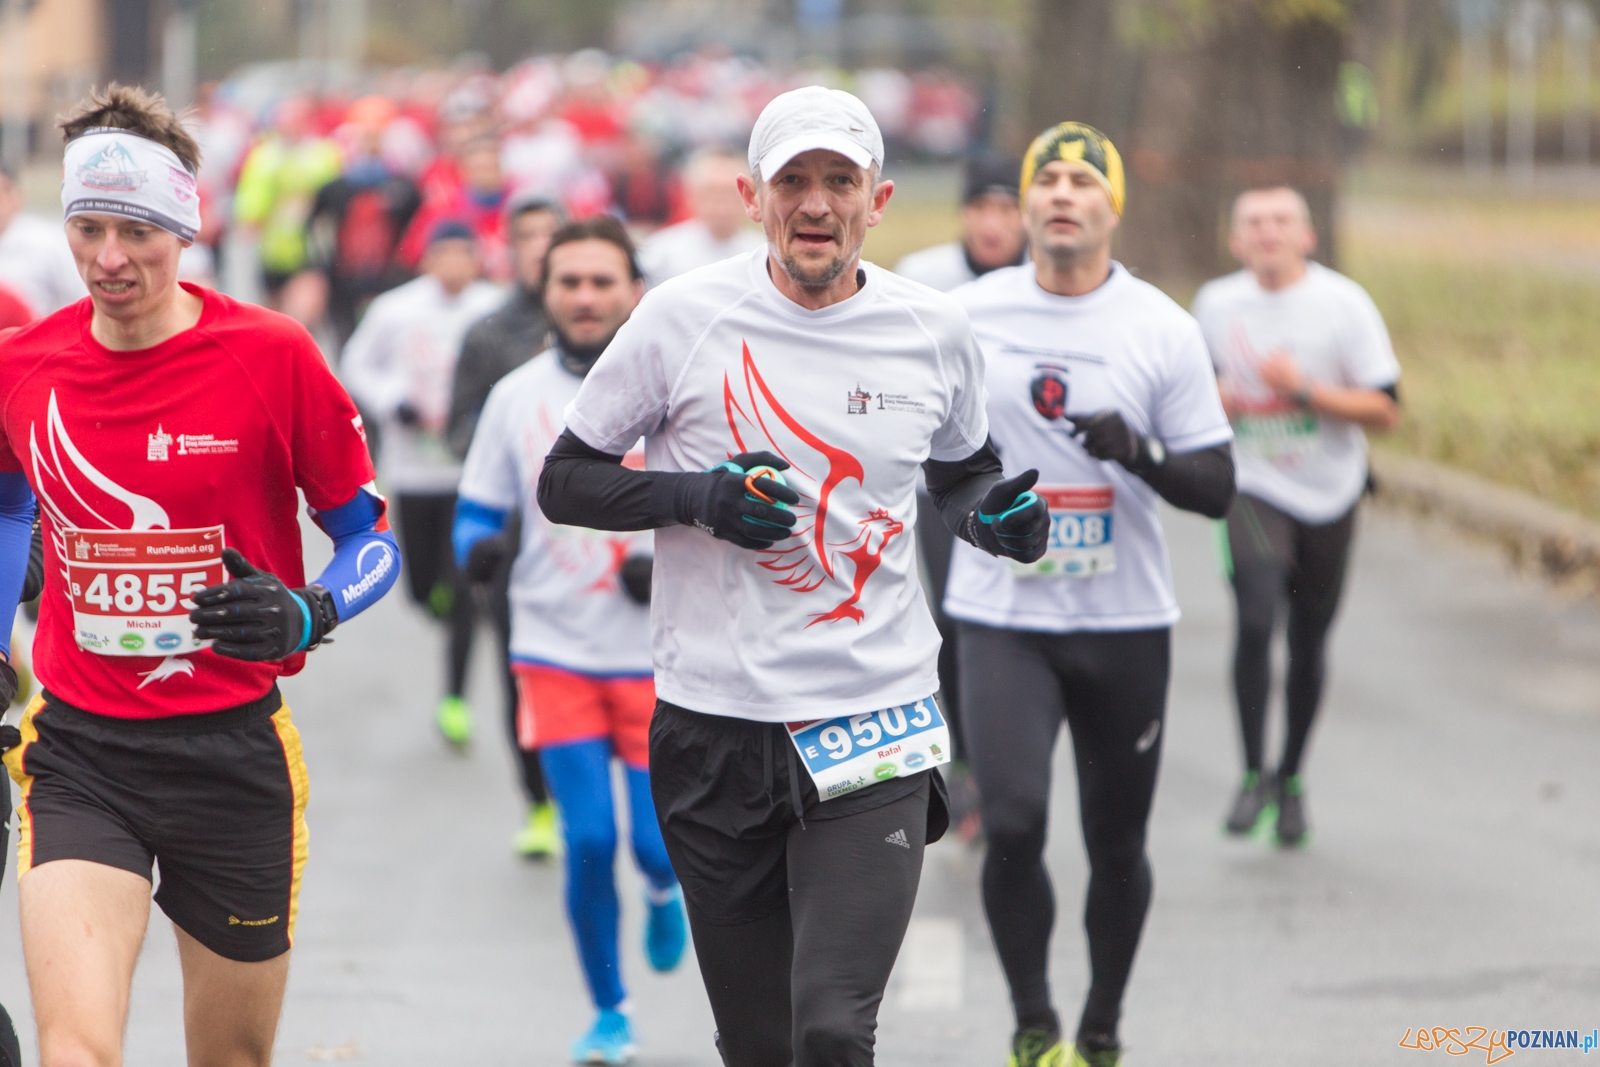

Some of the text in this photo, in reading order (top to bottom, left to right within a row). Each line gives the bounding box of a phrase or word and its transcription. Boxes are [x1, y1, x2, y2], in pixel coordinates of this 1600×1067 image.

[94, 201, 122, 210] NATURE
[124, 205, 149, 216] EVENTS
[876, 393, 885, 410] 1
[176, 434, 187, 455] 1
[146, 543, 214, 555] RunPoland.org
[341, 546, 393, 604] Mostostal
[71, 571, 208, 612] B 4855
[126, 620, 161, 629] Michał
[805, 699, 932, 760] E 9503
[877, 745, 902, 759] Rafał
[827, 779, 852, 793] GRUPA
[828, 784, 858, 797] LUXMED
[885, 836, 910, 849] adidas
